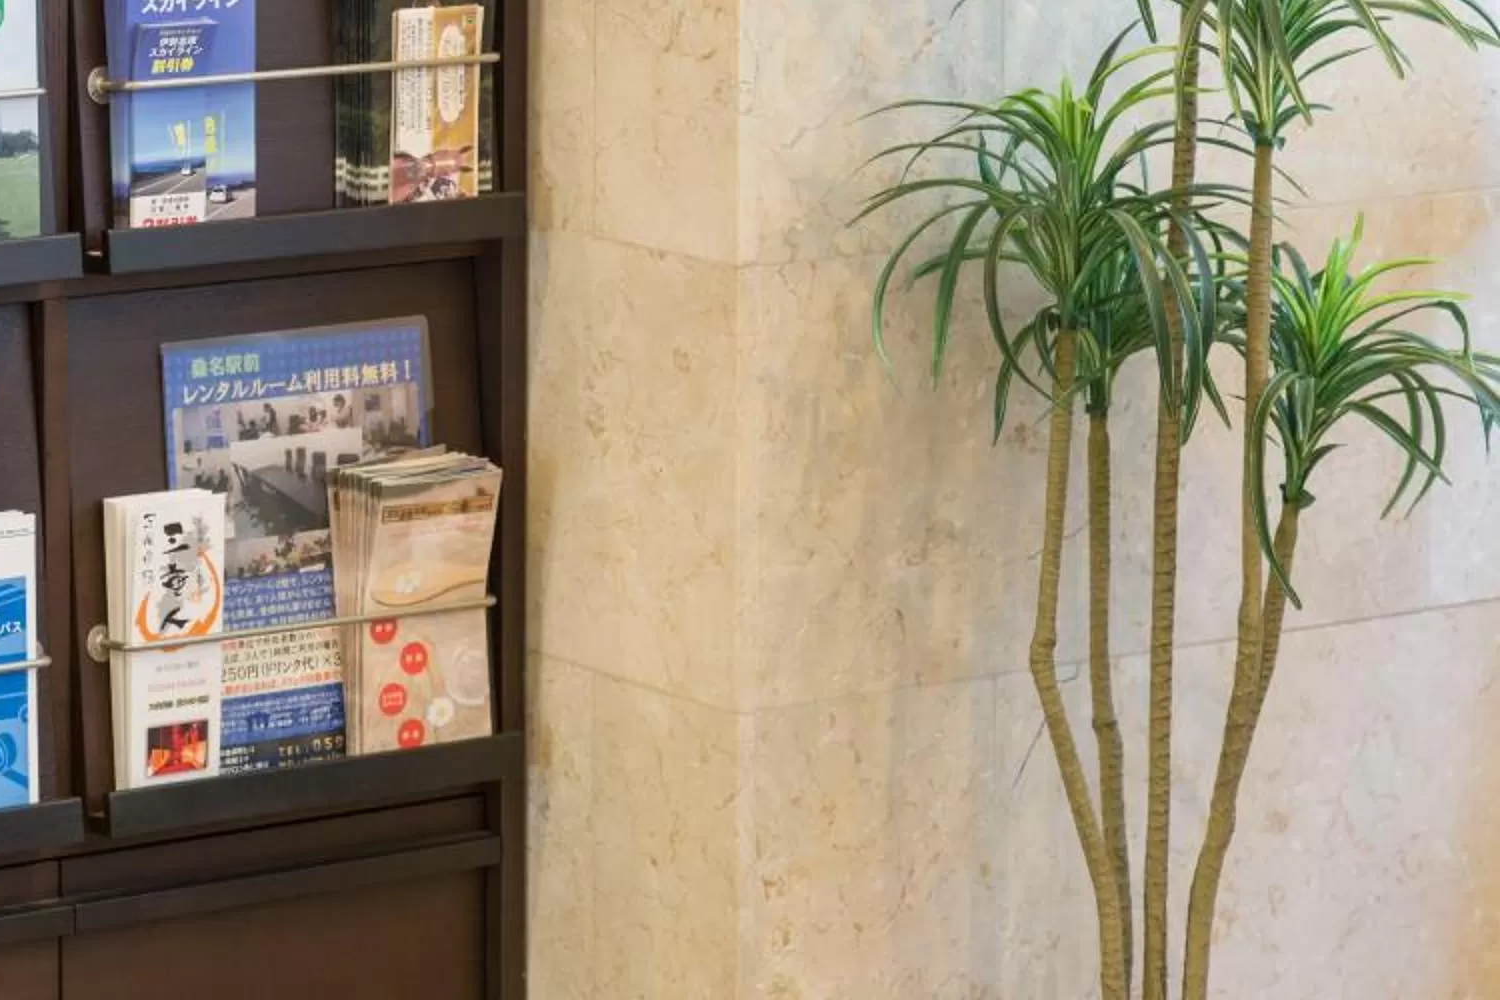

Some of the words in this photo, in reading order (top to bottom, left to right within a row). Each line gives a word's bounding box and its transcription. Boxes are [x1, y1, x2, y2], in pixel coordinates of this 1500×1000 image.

[182, 359, 412, 405] レンタルルーム利用料無料！
[190, 353, 261, 379] 桑名駅前
